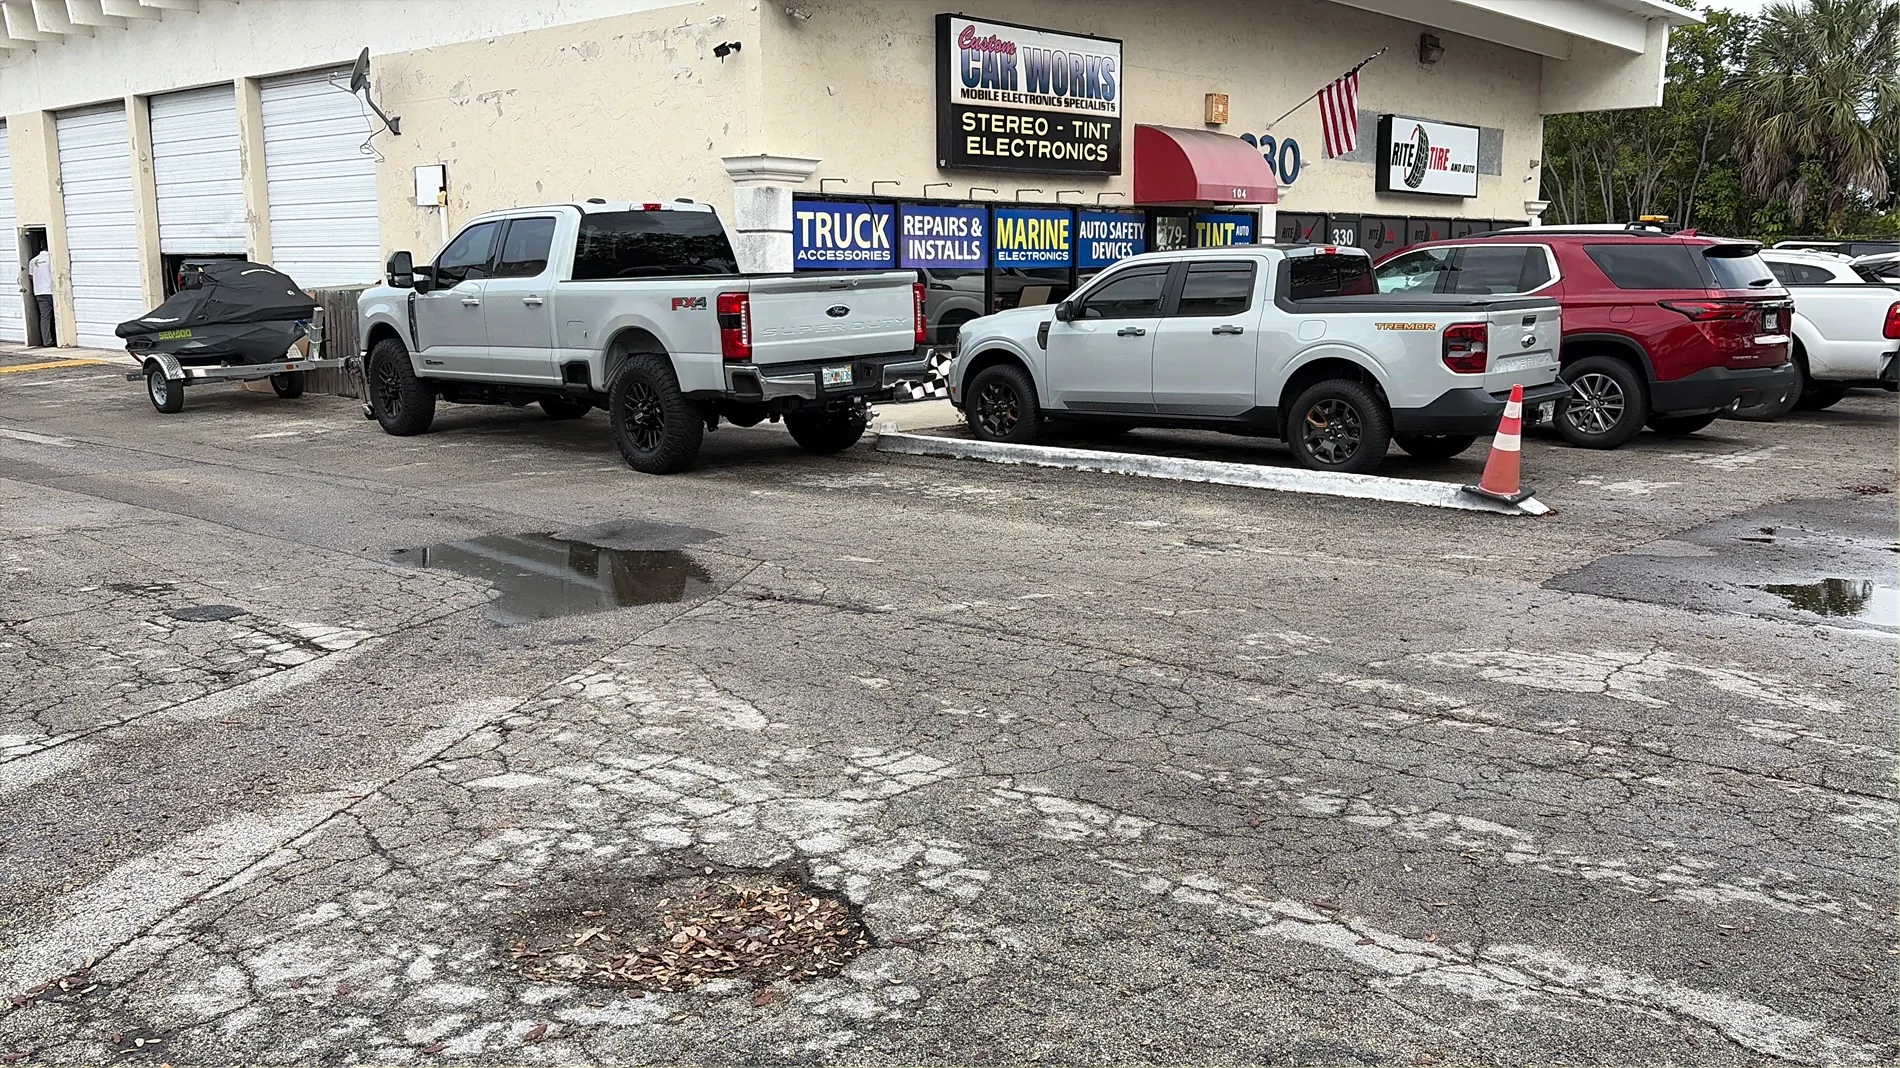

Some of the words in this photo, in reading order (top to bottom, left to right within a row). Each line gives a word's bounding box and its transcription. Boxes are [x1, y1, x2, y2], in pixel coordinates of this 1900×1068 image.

[958, 24, 1017, 55] Custom
[961, 46, 1018, 92] CAR
[1023, 46, 1116, 101] WORKS
[961, 88, 1000, 101] MOBILE
[1001, 92, 1062, 107] ELECTRONICS
[1064, 97, 1116, 112] SPECIALISTS
[962, 112, 1048, 136] STEREO
[1072, 120, 1112, 140] TINT
[966, 136, 1108, 162] ELECTRONICS
[1240, 133, 1300, 185] 30
[1391, 142, 1415, 167] RITE
[1429, 147, 1450, 171] TIRE
[1450, 163, 1461, 172] AND
[1462, 164, 1475, 174] AUTO
[1233, 188, 1246, 199] 104
[796, 211, 890, 249] TRUCK
[903, 215, 967, 237] REPAIRS
[970, 217, 982, 237] &
[996, 217, 1069, 250] MARINE
[1079, 221, 1107, 239] AUTO
[1109, 222, 1145, 240] SAFETY
[1196, 223, 1235, 248] TINT
[1235, 226, 1249, 236] AUTO
[1332, 229, 1354, 246] 330
[797, 250, 891, 261] ACCESSORIES
[909, 240, 981, 261] INSTALLS
[998, 251, 1069, 260] ELECTRONICS
[1092, 242, 1133, 259] DEVICES
[762, 323, 846, 337] SUPER
[852, 317, 908, 331] DUTY
[1375, 323, 1437, 331] TREMOR
